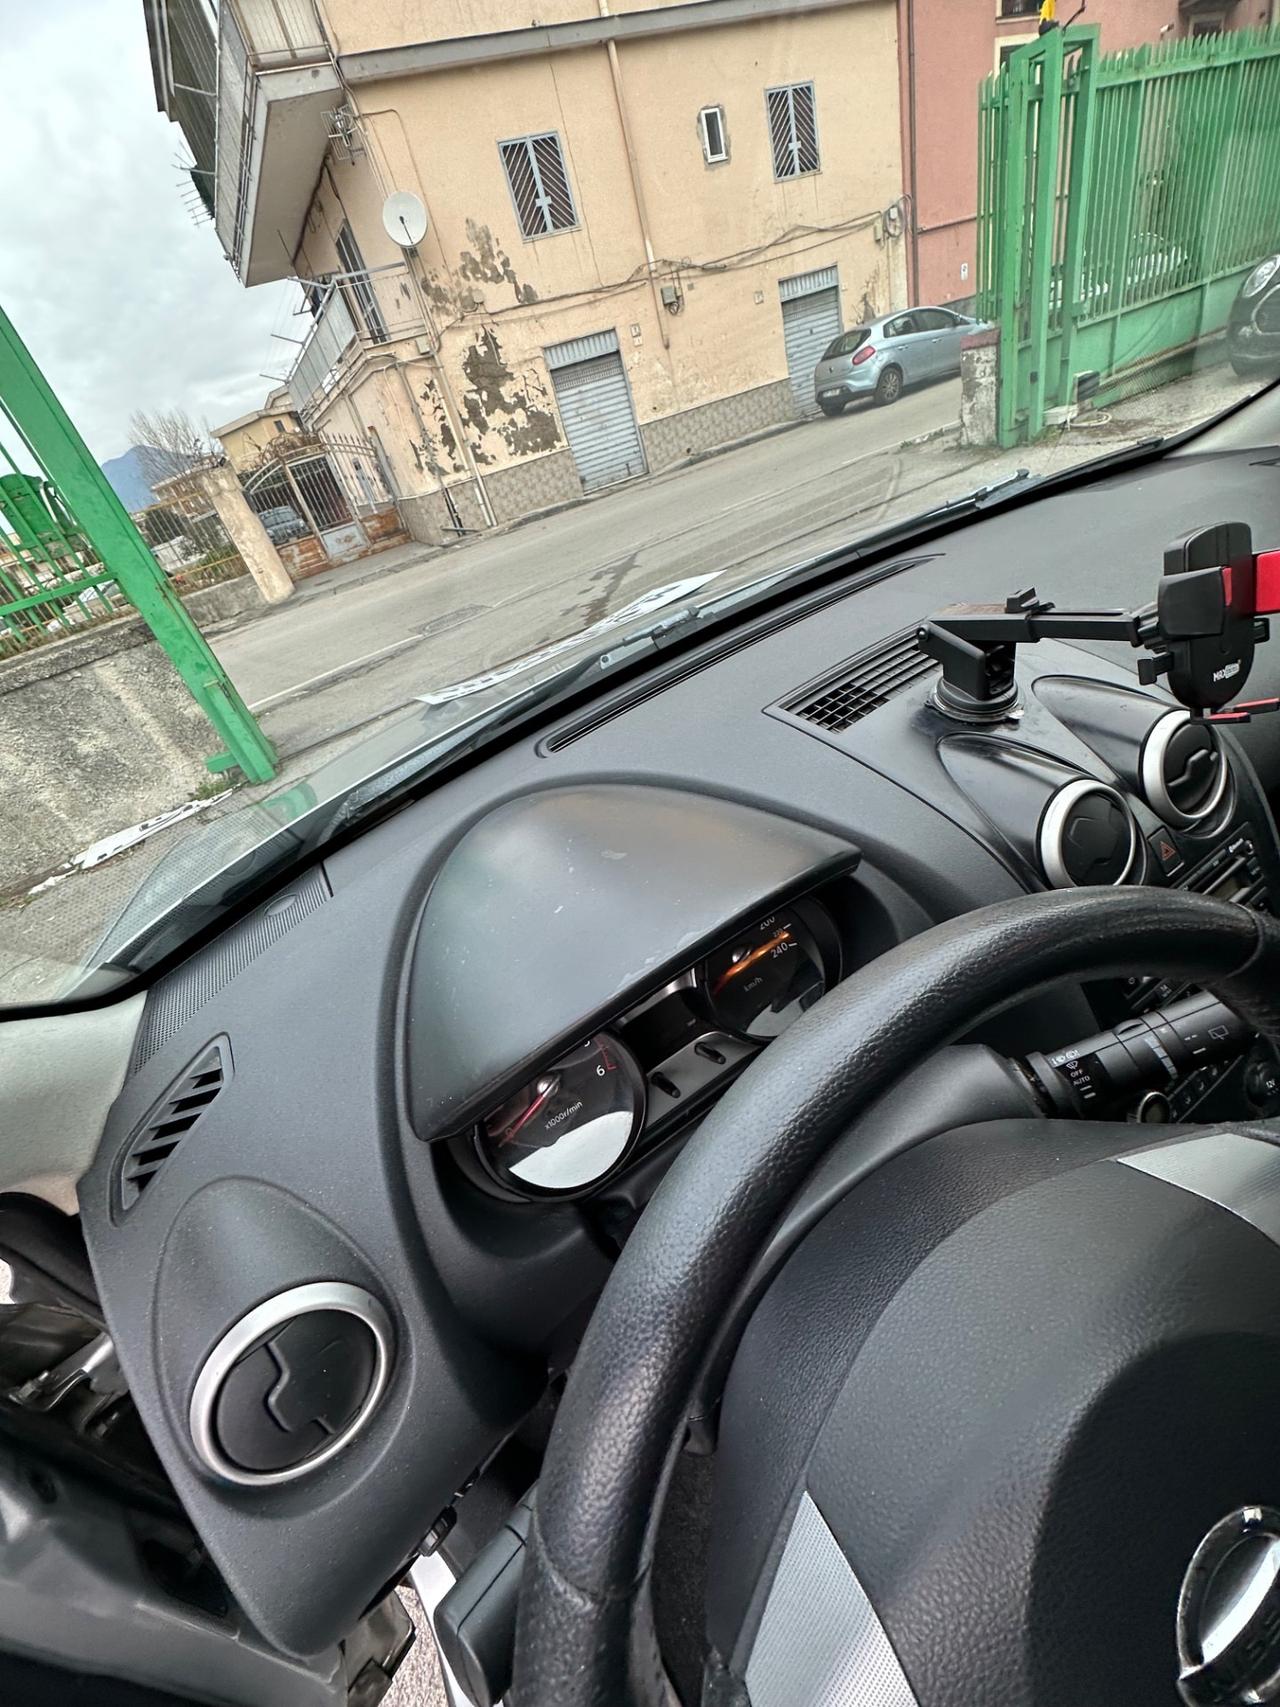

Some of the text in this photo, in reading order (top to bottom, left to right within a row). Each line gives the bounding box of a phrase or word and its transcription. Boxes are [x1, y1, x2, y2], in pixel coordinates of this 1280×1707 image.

[770, 942, 789, 959] 240
[595, 1064, 606, 1078] 6
[1070, 1067, 1084, 1079] OFF
[1073, 1075, 1091, 1087] AUTO
[543, 1101, 583, 1130] x1000r/min
